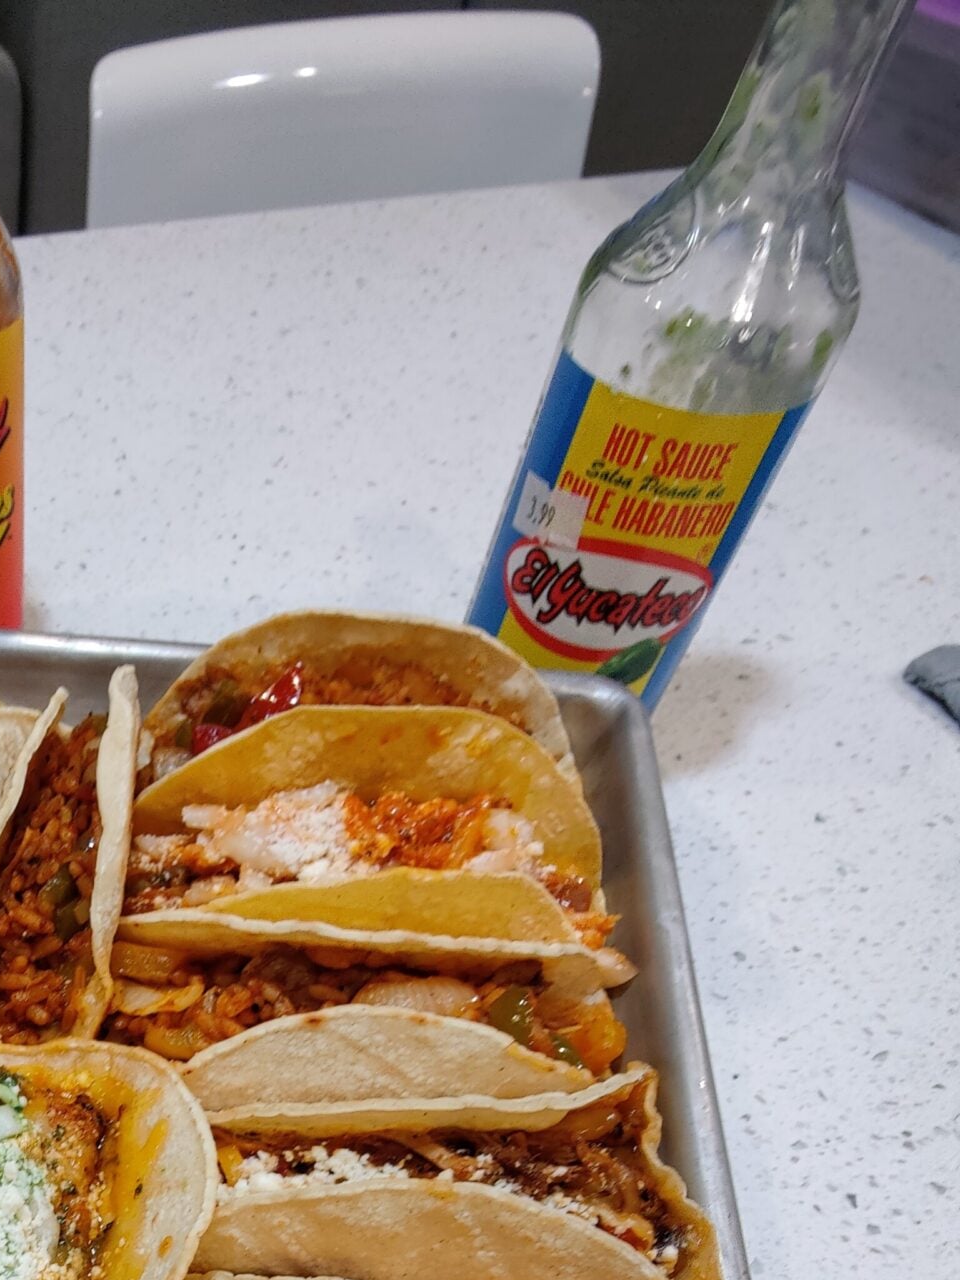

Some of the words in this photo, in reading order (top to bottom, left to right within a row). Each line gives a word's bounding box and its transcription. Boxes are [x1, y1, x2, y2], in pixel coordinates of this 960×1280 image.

[602, 422, 656, 471] HOT
[652, 437, 739, 481] SAUCE
[586, 461, 632, 489] Salsa
[705, 483, 727, 499] de
[612, 496, 736, 538] HABANERO
[512, 548, 560, 606] El
